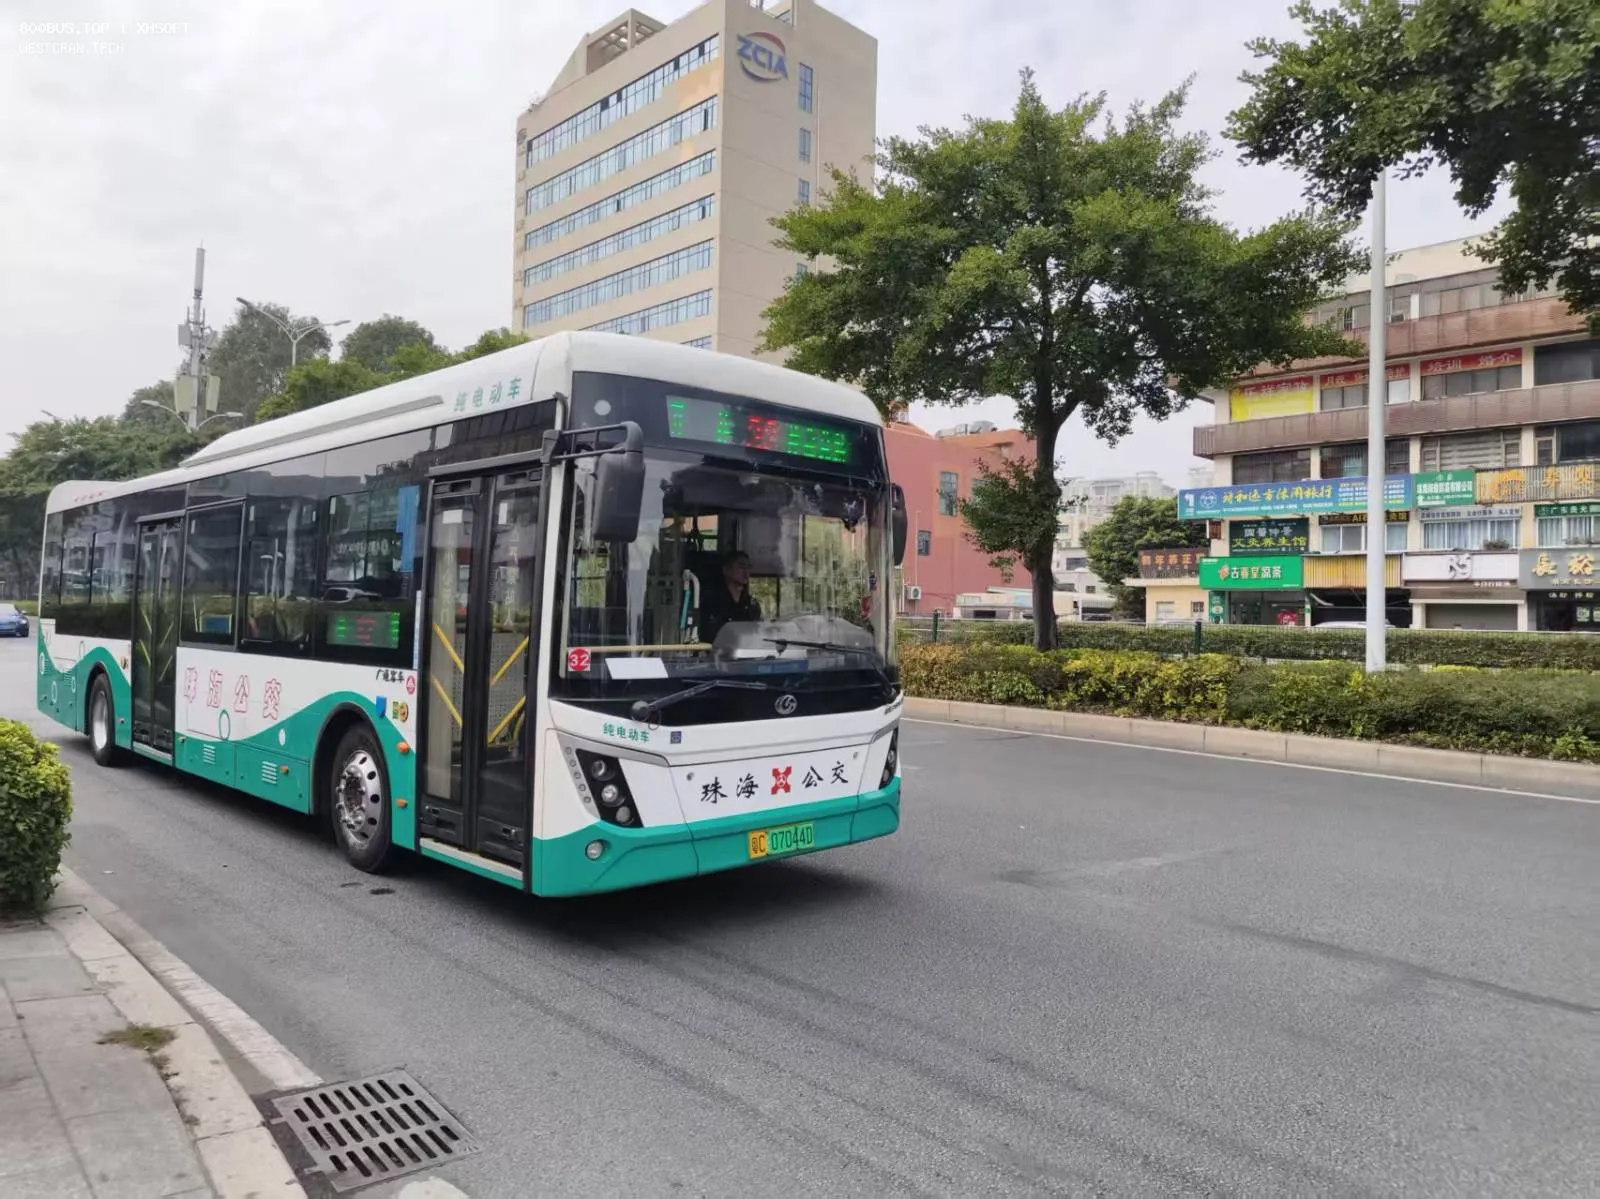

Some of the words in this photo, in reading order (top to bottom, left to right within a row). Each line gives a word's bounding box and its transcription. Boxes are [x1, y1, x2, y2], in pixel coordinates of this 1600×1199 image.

[454, 378, 522, 412] 纯电动车
[568, 652, 591, 667] 32
[603, 722, 650, 743] 纯电动车
[700, 773, 759, 804] 珠海
[802, 761, 849, 789] 公交
